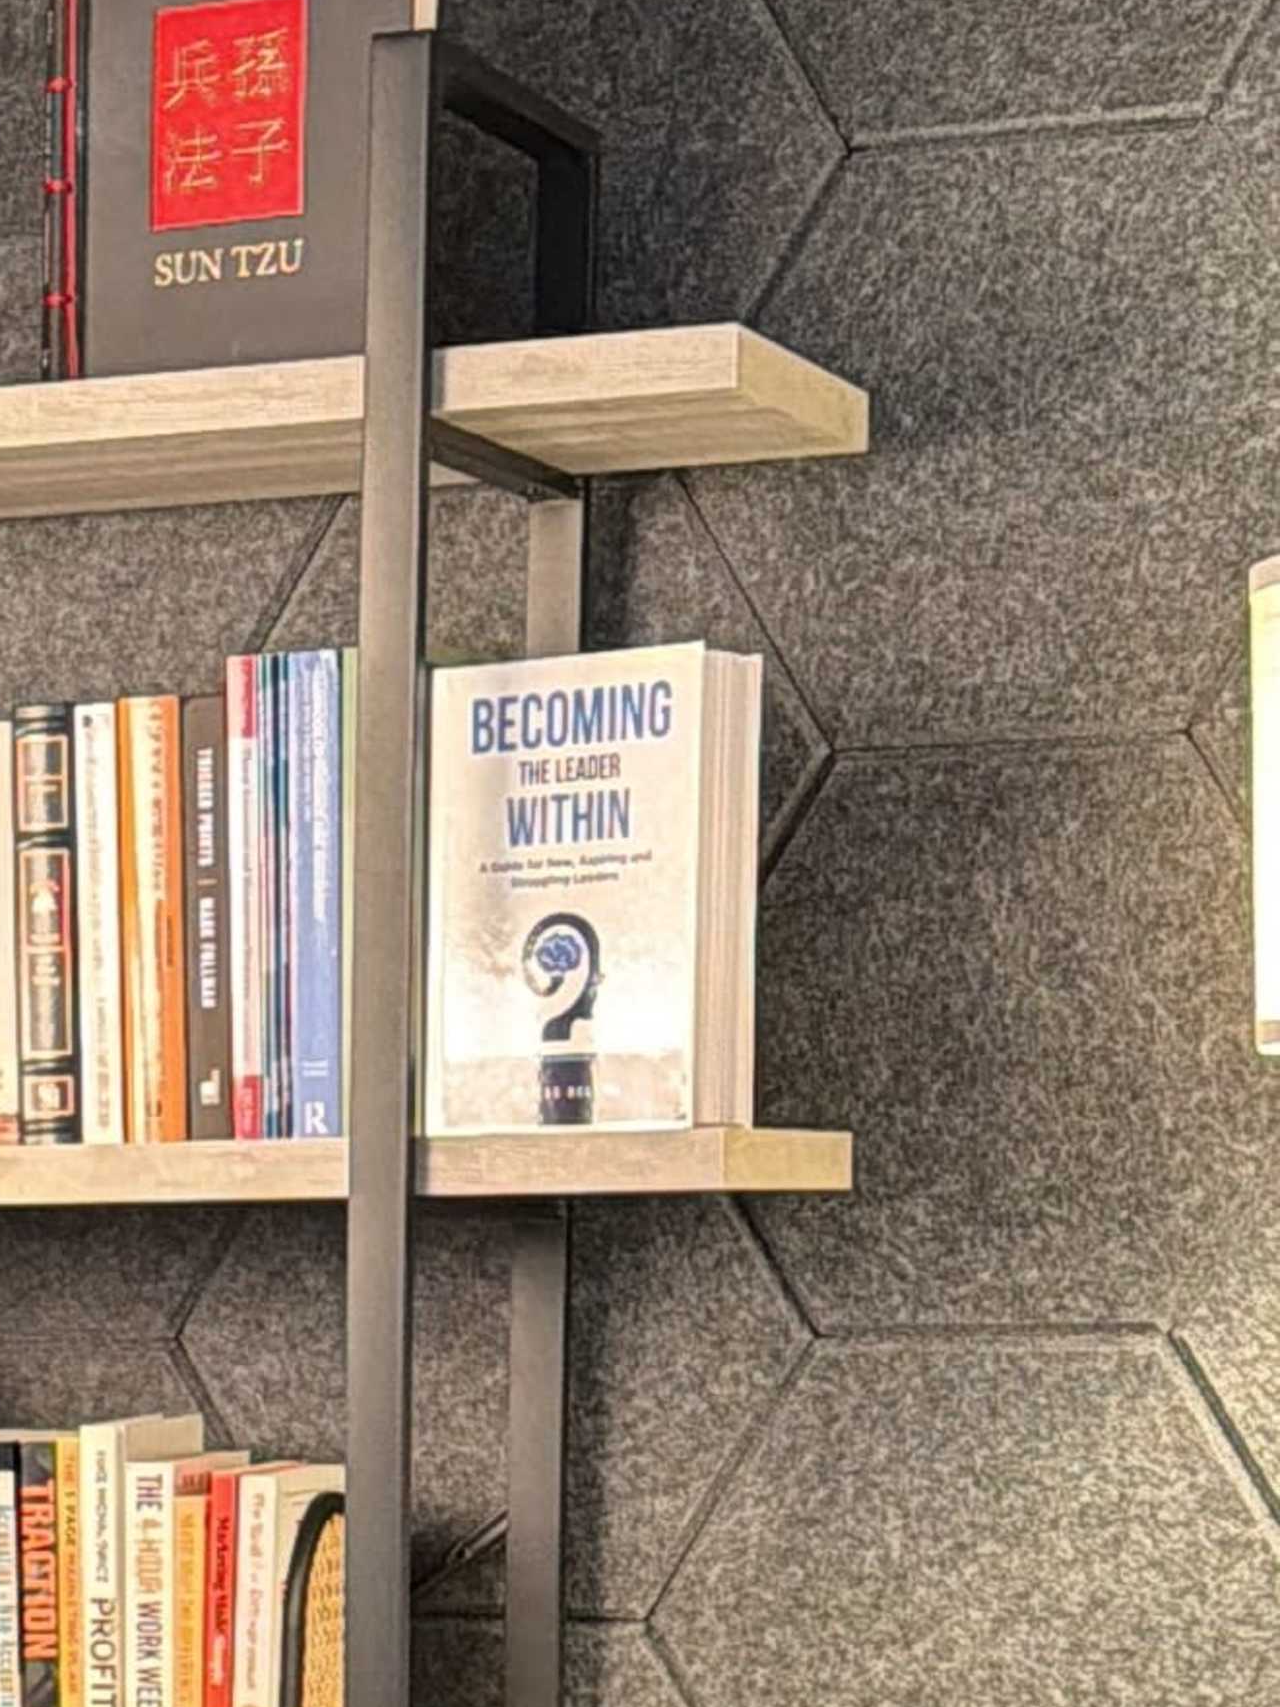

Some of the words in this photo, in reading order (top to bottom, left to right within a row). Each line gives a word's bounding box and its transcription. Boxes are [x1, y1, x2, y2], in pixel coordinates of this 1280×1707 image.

[154, 247, 224, 287] SUN
[230, 238, 304, 278] TZU
[471, 680, 672, 754] BECOMING
[519, 759, 551, 786] THE
[555, 752, 621, 783] LEADER
[507, 787, 631, 848] WITHIN
[136, 1474, 163, 1512] THE
[21, 1478, 57, 1659] TRACTION
[136, 1601, 163, 1662] WORK
